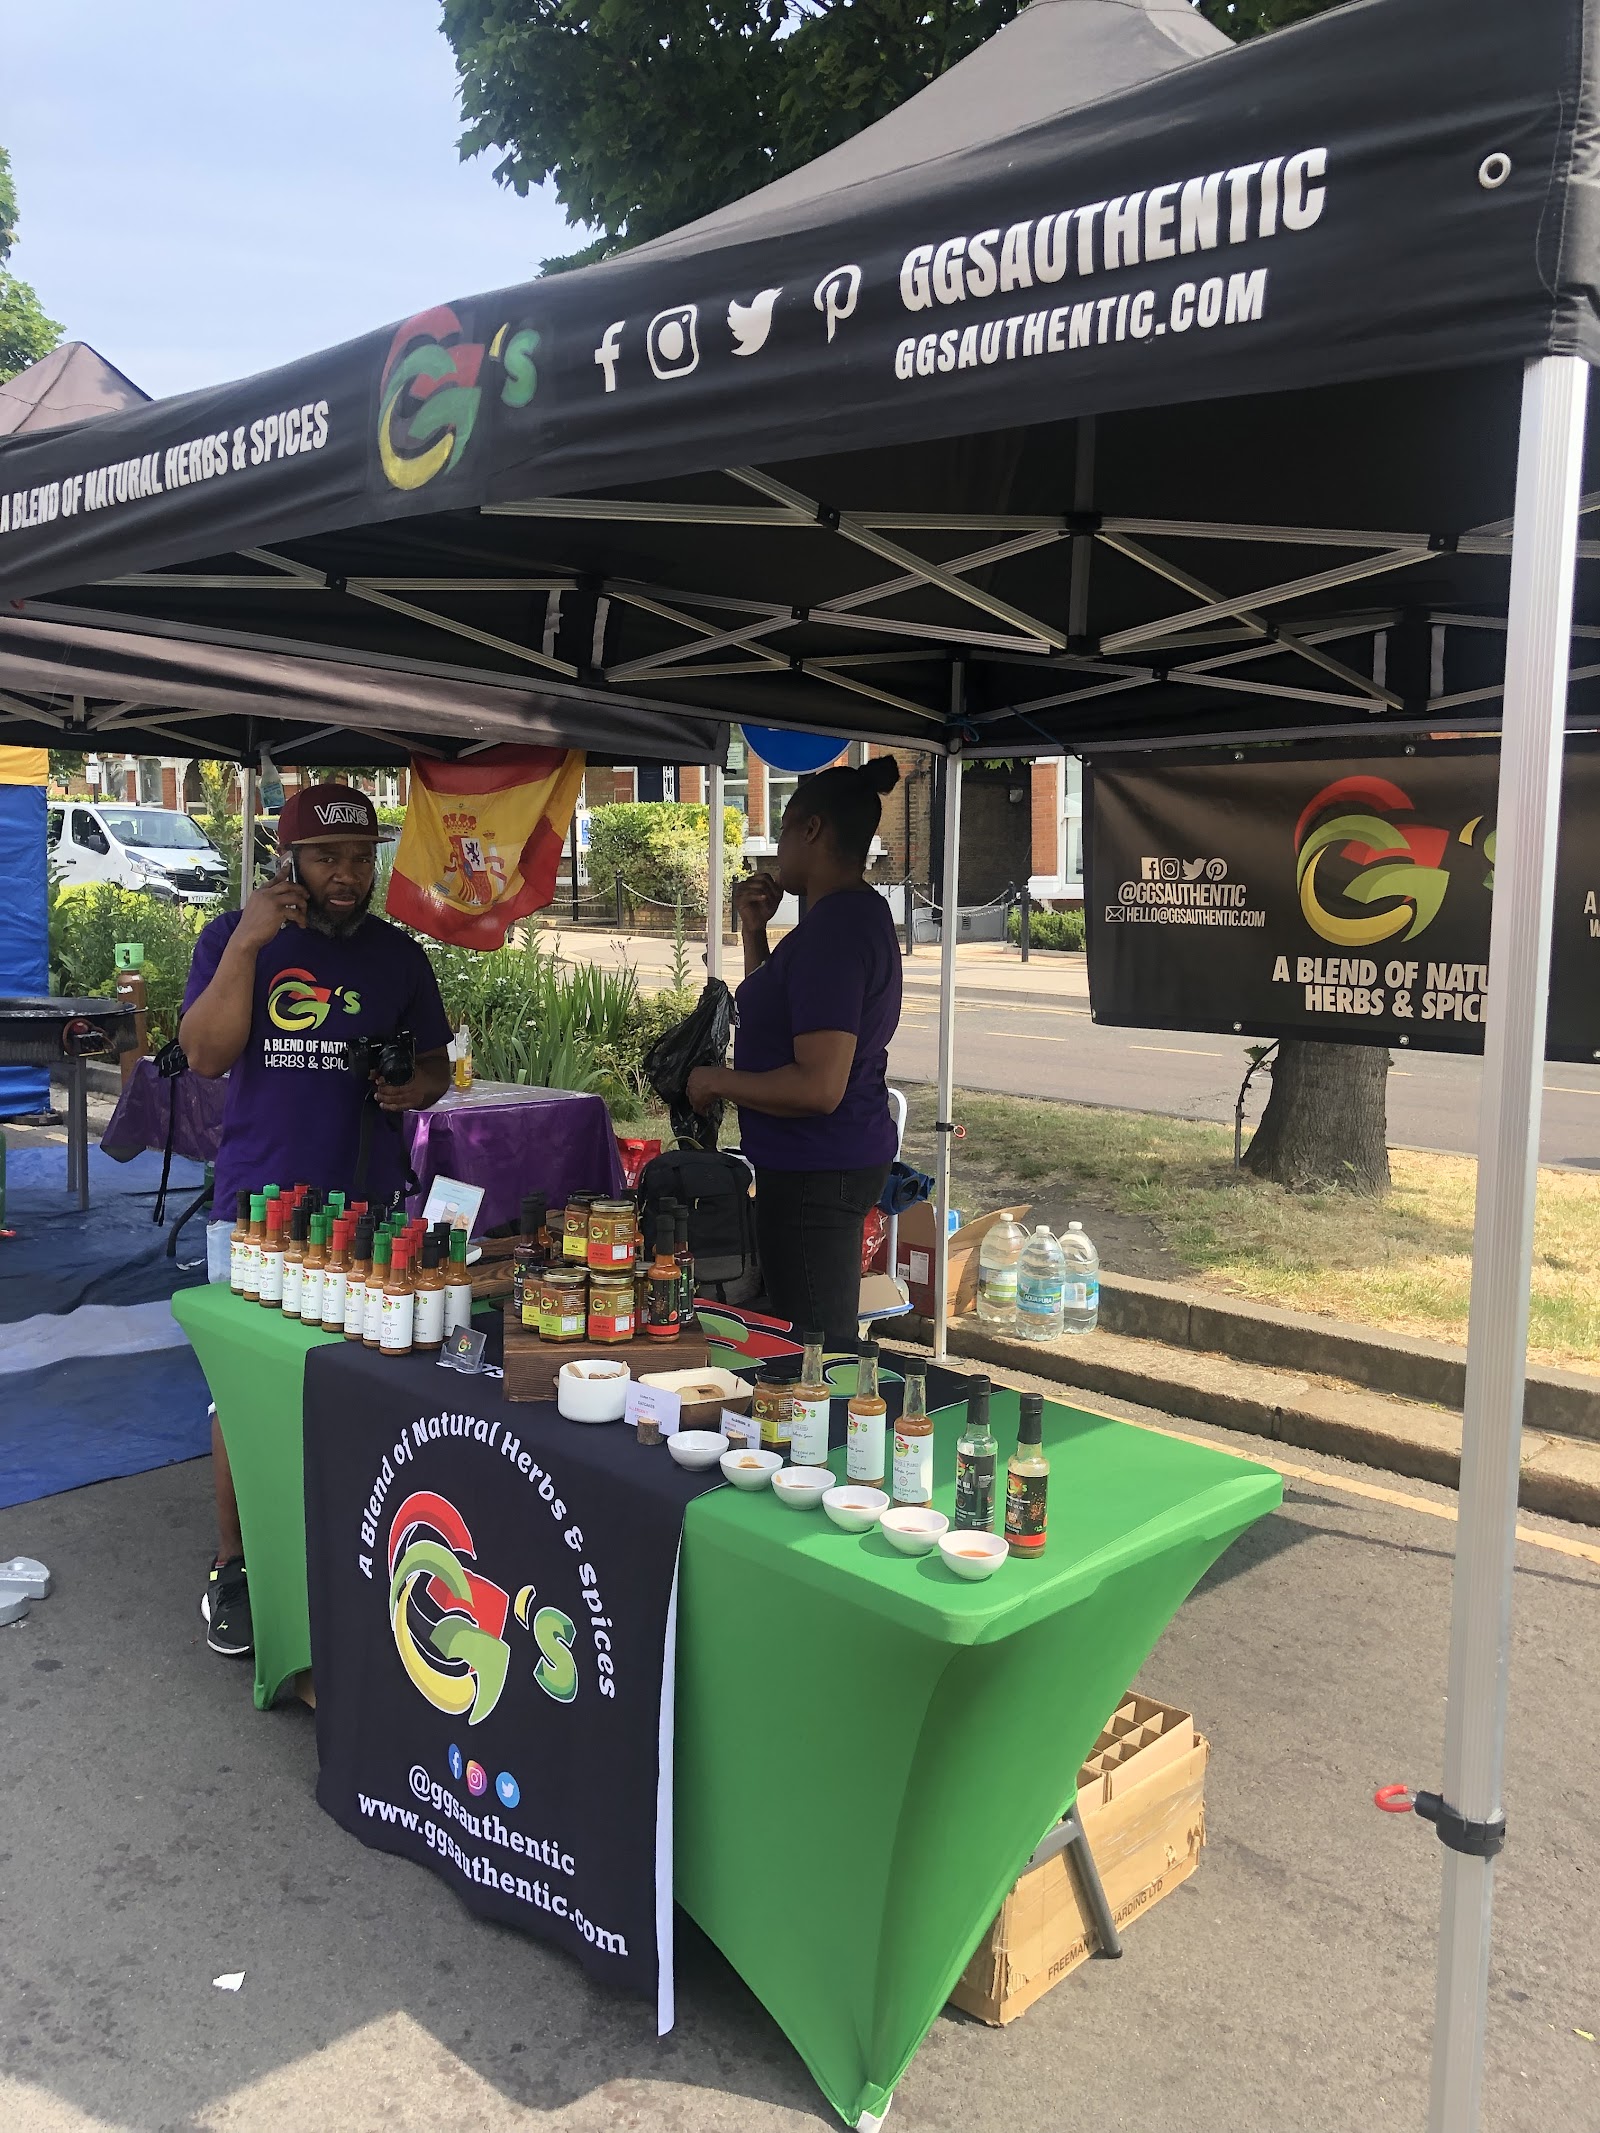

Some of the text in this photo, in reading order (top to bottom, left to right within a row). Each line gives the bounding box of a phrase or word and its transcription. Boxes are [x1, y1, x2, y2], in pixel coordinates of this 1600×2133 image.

[900, 147, 1328, 313] GGSAUTHENTIC
[894, 268, 1269, 380] GGSAUTHENTIC.COM
[0, 400, 330, 533] A BLEND OF NATURAL HERBS & SPICES
[314, 802, 369, 826] VANS
[1117, 881, 1247, 908] @GGSAUTHENTIC
[1583, 890, 1597, 914] A
[1126, 906, 1266, 928] HELLO@GGSAUTHENTIC.COM
[1272, 955, 1488, 992] A BLEND OF NATU
[1305, 985, 1385, 1016] HERBS
[1391, 989, 1414, 1019] &
[263, 1038, 272, 1052] A
[272, 1038, 304, 1053] BLEND
[305, 1039, 319, 1053] OF
[264, 1053, 305, 1069] HERBS
[307, 1055, 319, 1070] &
[393, 1428, 414, 1465] of
[411, 1411, 502, 1447] Natural
[500, 1431, 568, 1521] Herbs
[360, 1455, 395, 1548] Blend
[564, 1525, 585, 1553] &
[358, 1554, 373, 1580] A
[408, 1764, 576, 1876] @ggsauthentic
[358, 1792, 629, 1957] www.ggsauthentic.com
[1048, 1936, 1090, 1981] FREEMAN
[1148, 1879, 1163, 1898] LTD
